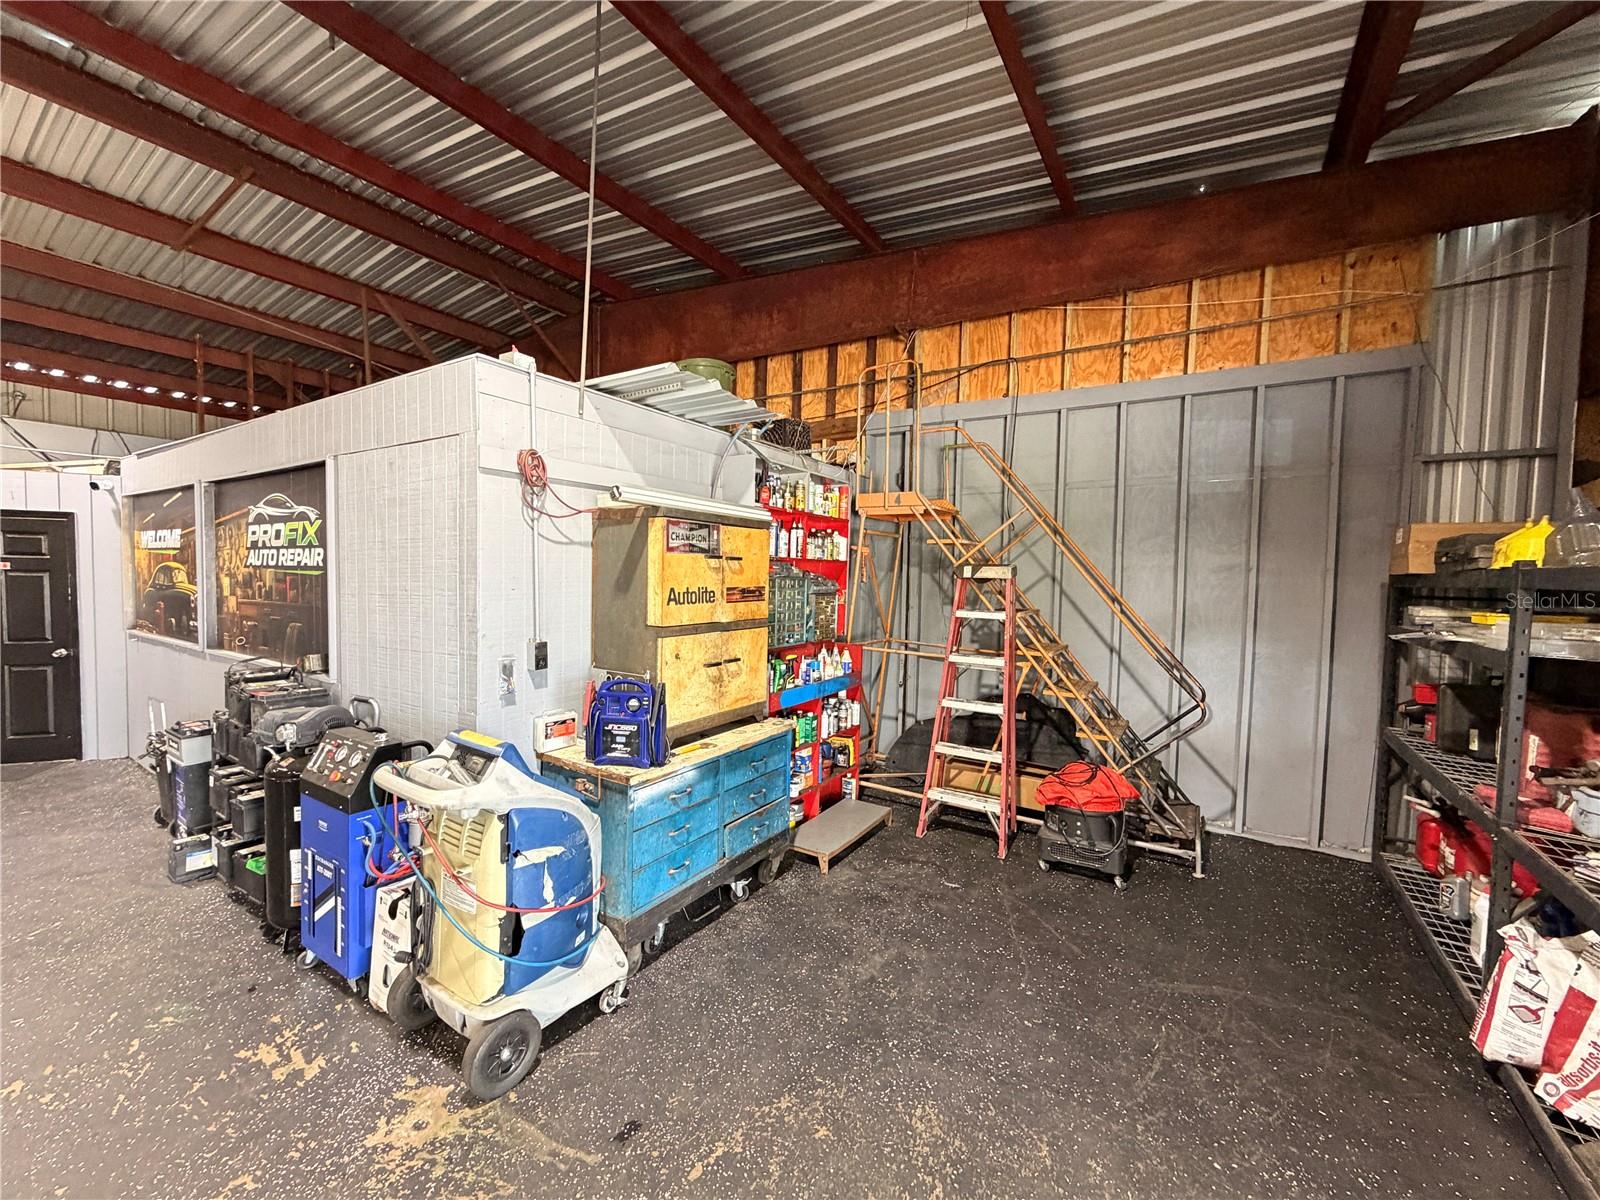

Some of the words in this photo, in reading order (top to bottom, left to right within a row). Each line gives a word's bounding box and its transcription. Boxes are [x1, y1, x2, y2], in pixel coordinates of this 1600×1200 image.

[140, 528, 182, 548] WELCOME
[246, 519, 322, 548] PROFIX
[670, 531, 707, 543] CHAMPION
[246, 548, 278, 566] AUTO
[278, 547, 324, 566] REPAIR
[666, 586, 716, 606] Autolite
